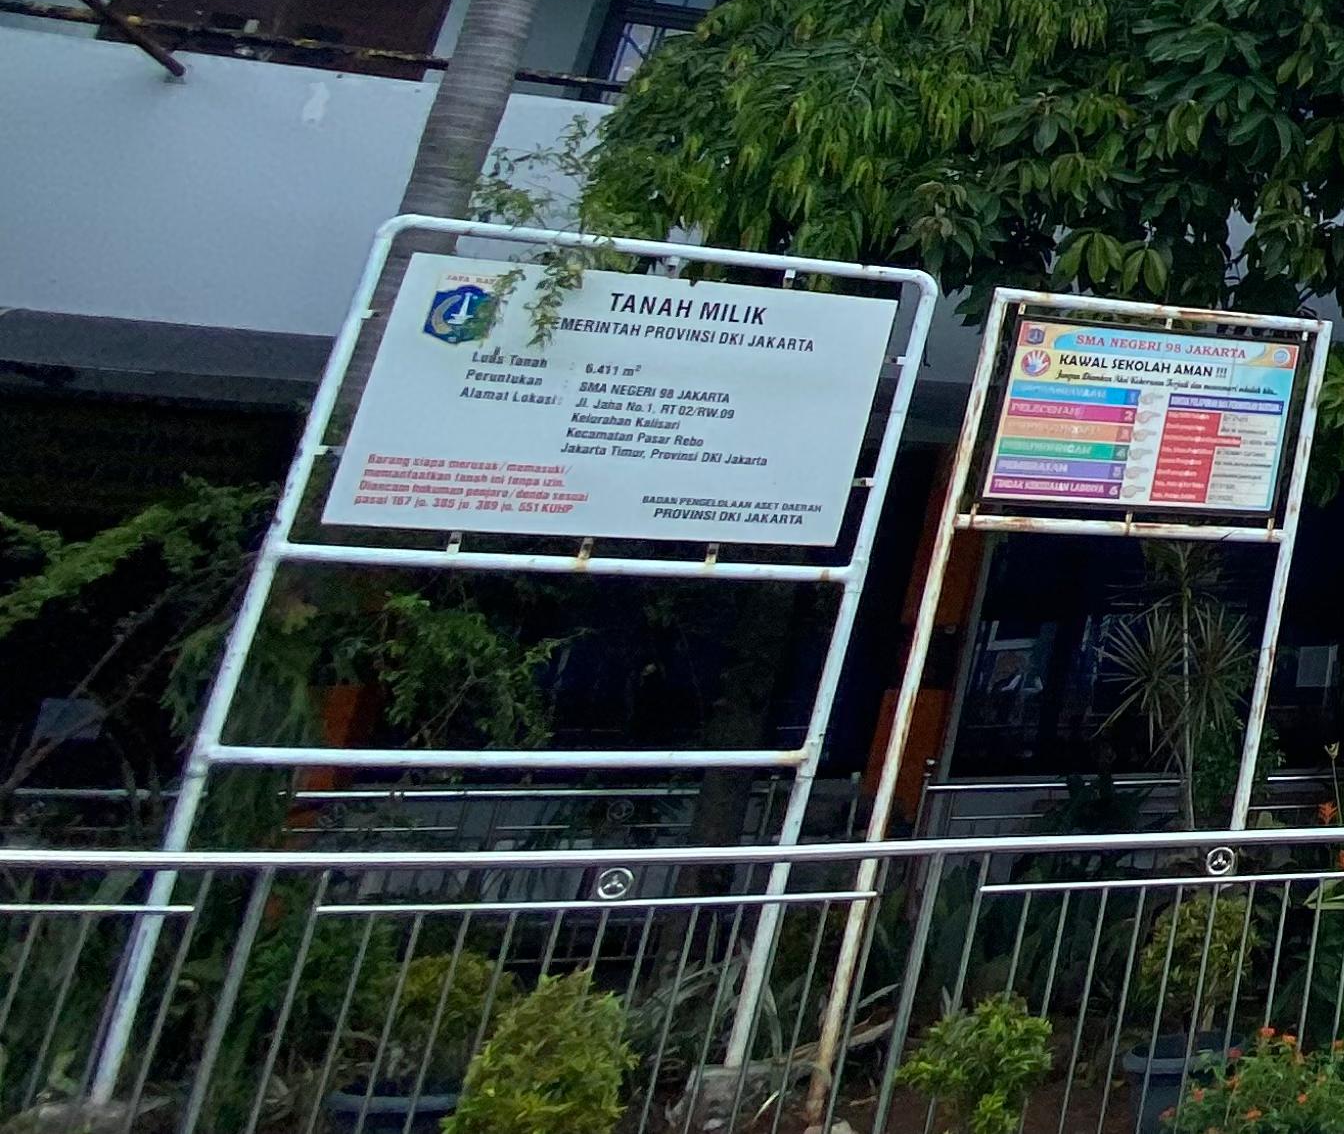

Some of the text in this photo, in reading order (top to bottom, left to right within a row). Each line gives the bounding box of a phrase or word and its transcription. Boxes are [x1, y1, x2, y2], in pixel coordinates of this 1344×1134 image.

[610, 292, 768, 326] TANAH MILIK
[551, 317, 815, 353] EMERINTAH PROVINSI DKI JAKARTA
[1076, 334, 1246, 359] SMA NEGERI 98 JAKARTA
[510, 355, 547, 368] Tanah
[1059, 354, 1108, 369] KAWAL
[1112, 358, 1171, 375] SEKOLAH
[1174, 364, 1213, 377] AMAN
[465, 369, 730, 404] Peruntukan SMA NEGERI 98 JAKARTA
[459, 386, 509, 401] Alamat
[660, 404, 676, 415] RT
[571, 413, 680, 430] Kelurahan Kalisari
[1124, 411, 1133, 421] 2
[566, 427, 704, 447] Kecamatan Pasar Rebo
[560, 442, 607, 456] Jakarta
[650, 449, 697, 462] Provinsi
[701, 452, 722, 463] DKI
[724, 454, 768, 467] Jakarta
[1109, 486, 1118, 496] 6
[642, 495, 678, 505] BADAN
[679, 497, 752, 509] PENGELOLAAN
[781, 503, 822, 513] DAERAH
[653, 508, 804, 525] PROVINSI DKI JAKARTA
